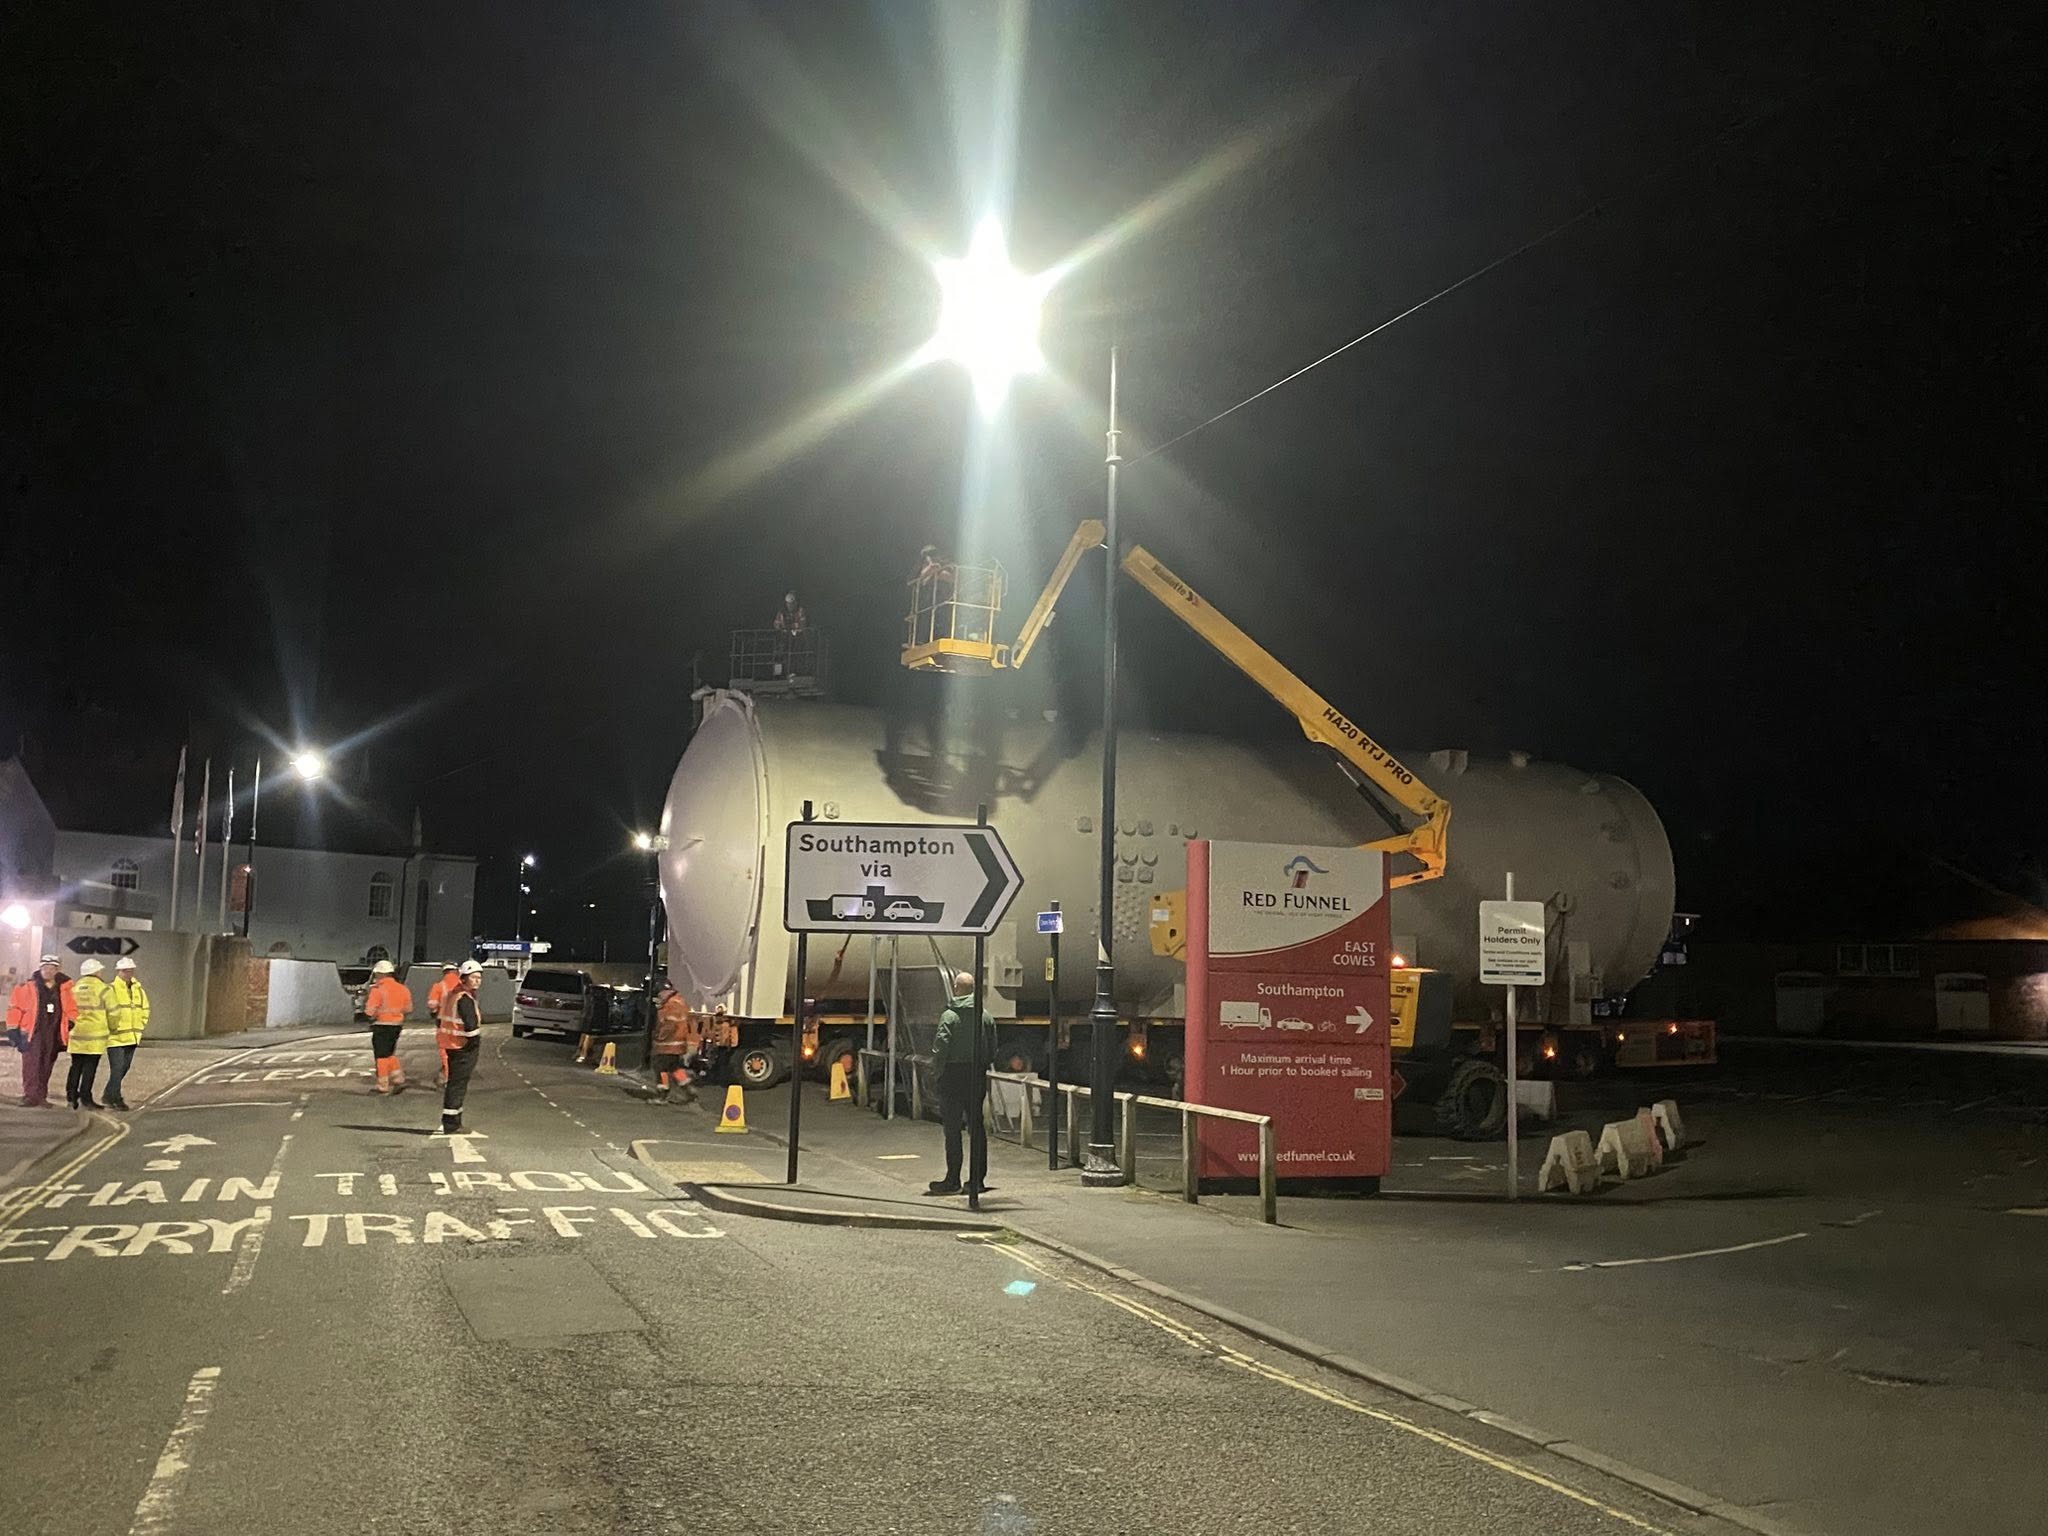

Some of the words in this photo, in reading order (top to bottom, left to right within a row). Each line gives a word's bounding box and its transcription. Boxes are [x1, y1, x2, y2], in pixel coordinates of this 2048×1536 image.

[1323, 707, 1358, 739] HA20
[1357, 737, 1385, 761] RTJ
[1384, 759, 1413, 785] PRO
[799, 833, 955, 857] Southampton
[860, 860, 892, 877] via
[1243, 891, 1276, 907] RED
[1284, 893, 1351, 911] FUNNEL
[1498, 926, 1527, 935] Permit
[1344, 941, 1376, 953] EAST
[1484, 936, 1518, 945] Holders
[1520, 936, 1541, 946] Only
[1332, 953, 1376, 967] COWES
[1257, 983, 1345, 1000] Southampton
[1241, 1053, 1291, 1064] Maximum
[1295, 1054, 1326, 1065] arrival
[1329, 1055, 1352, 1066] time
[195, 1067, 376, 1084] CLEAR
[1220, 1066, 1226, 1076] 1
[1230, 1066, 1254, 1076] Hour
[1258, 1066, 1283, 1078] prior
[1286, 1067, 1297, 1077] to
[1301, 1066, 1338, 1077] booked
[1341, 1067, 1372, 1080] sailing
[1237, 1150, 1356, 1163] wwedfunnel.co.uk
[0, 1215, 271, 1263] ERRY
[289, 1205, 727, 1248] TRAFFIC
